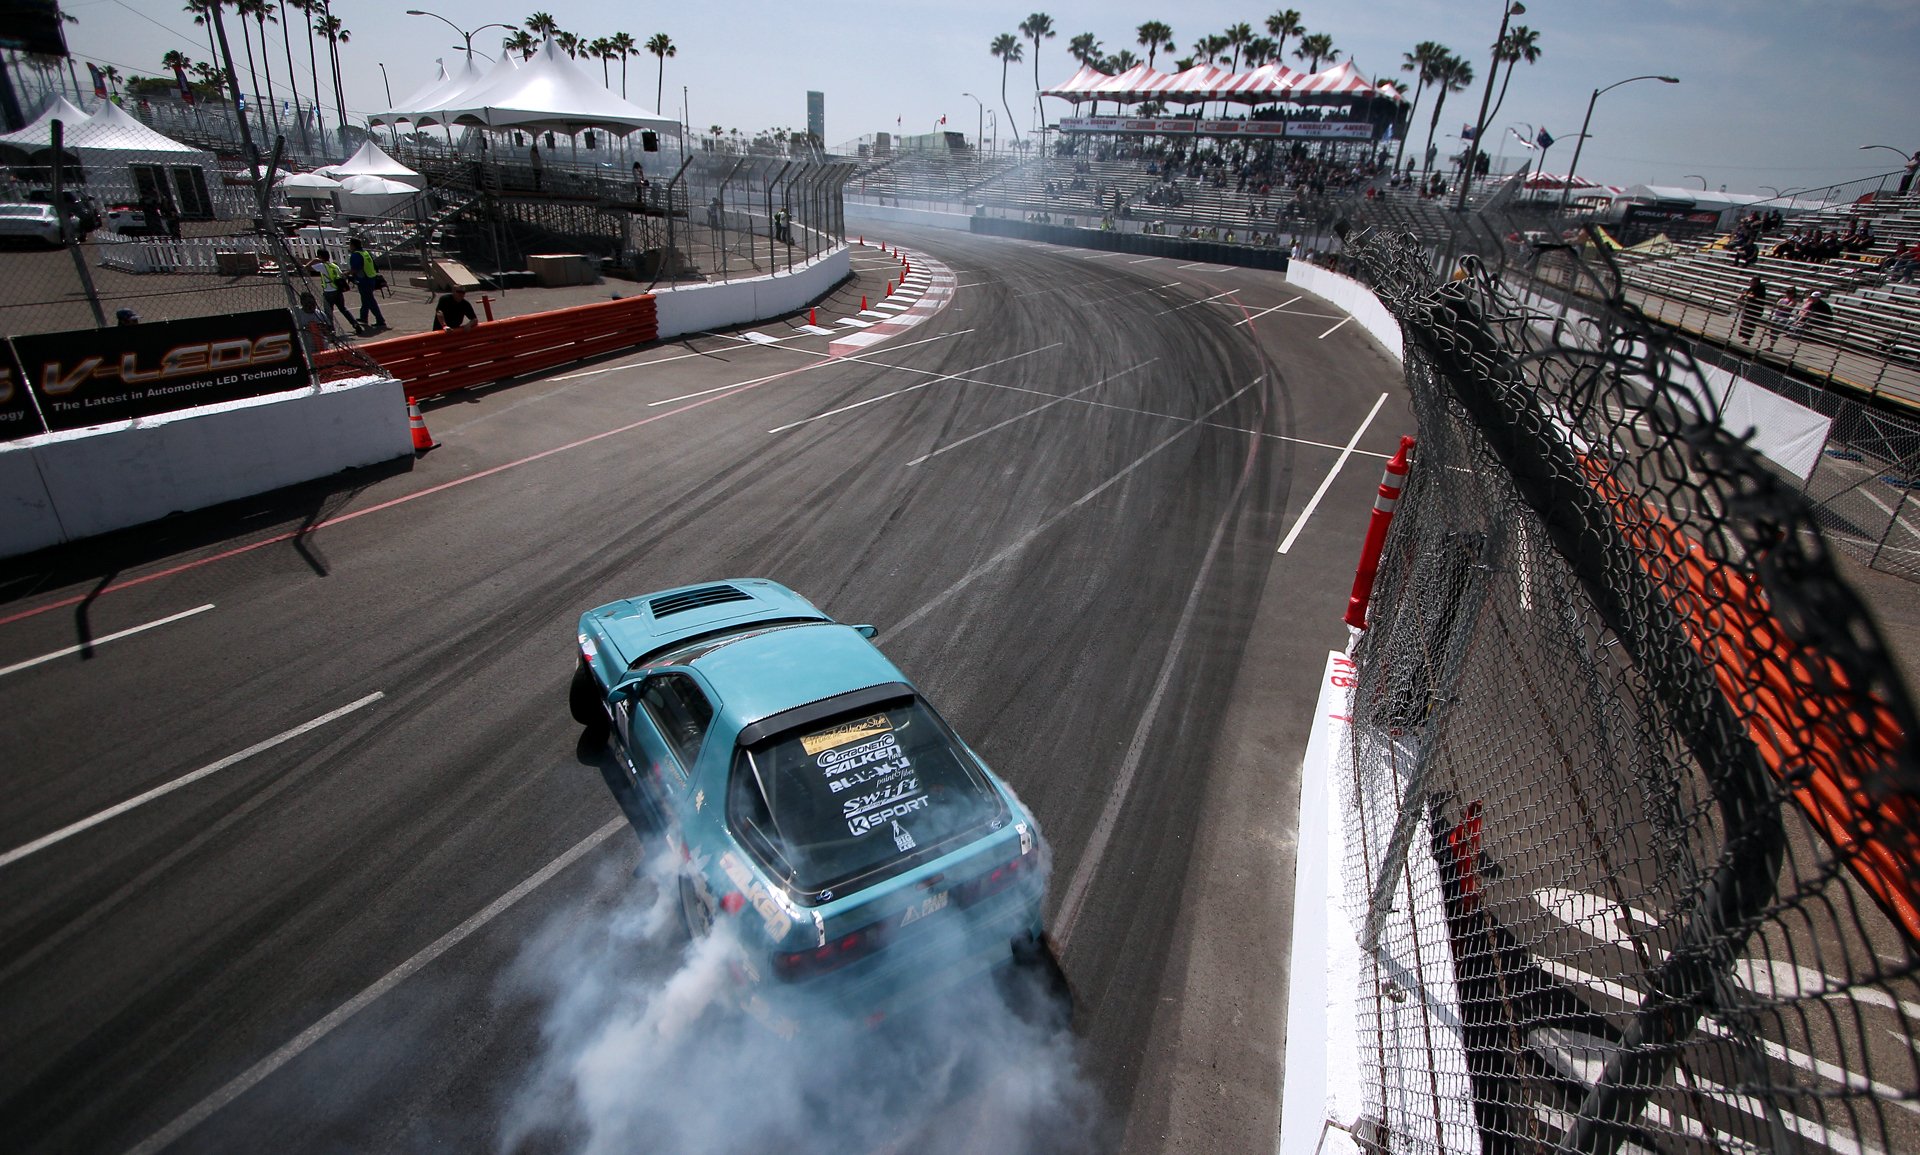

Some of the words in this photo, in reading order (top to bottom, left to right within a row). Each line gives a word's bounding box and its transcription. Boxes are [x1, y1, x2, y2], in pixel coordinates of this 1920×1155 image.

[42, 332, 293, 395] V-LEDS
[53, 400, 80, 412] The
[85, 392, 128, 407] Latest
[131, 390, 143, 399] in
[147, 379, 213, 397] Automotive
[216, 374, 239, 386] LED
[242, 365, 298, 382] Technology
[817, 733, 895, 767] CARBONETIC
[823, 745, 902, 778] FALKEN
